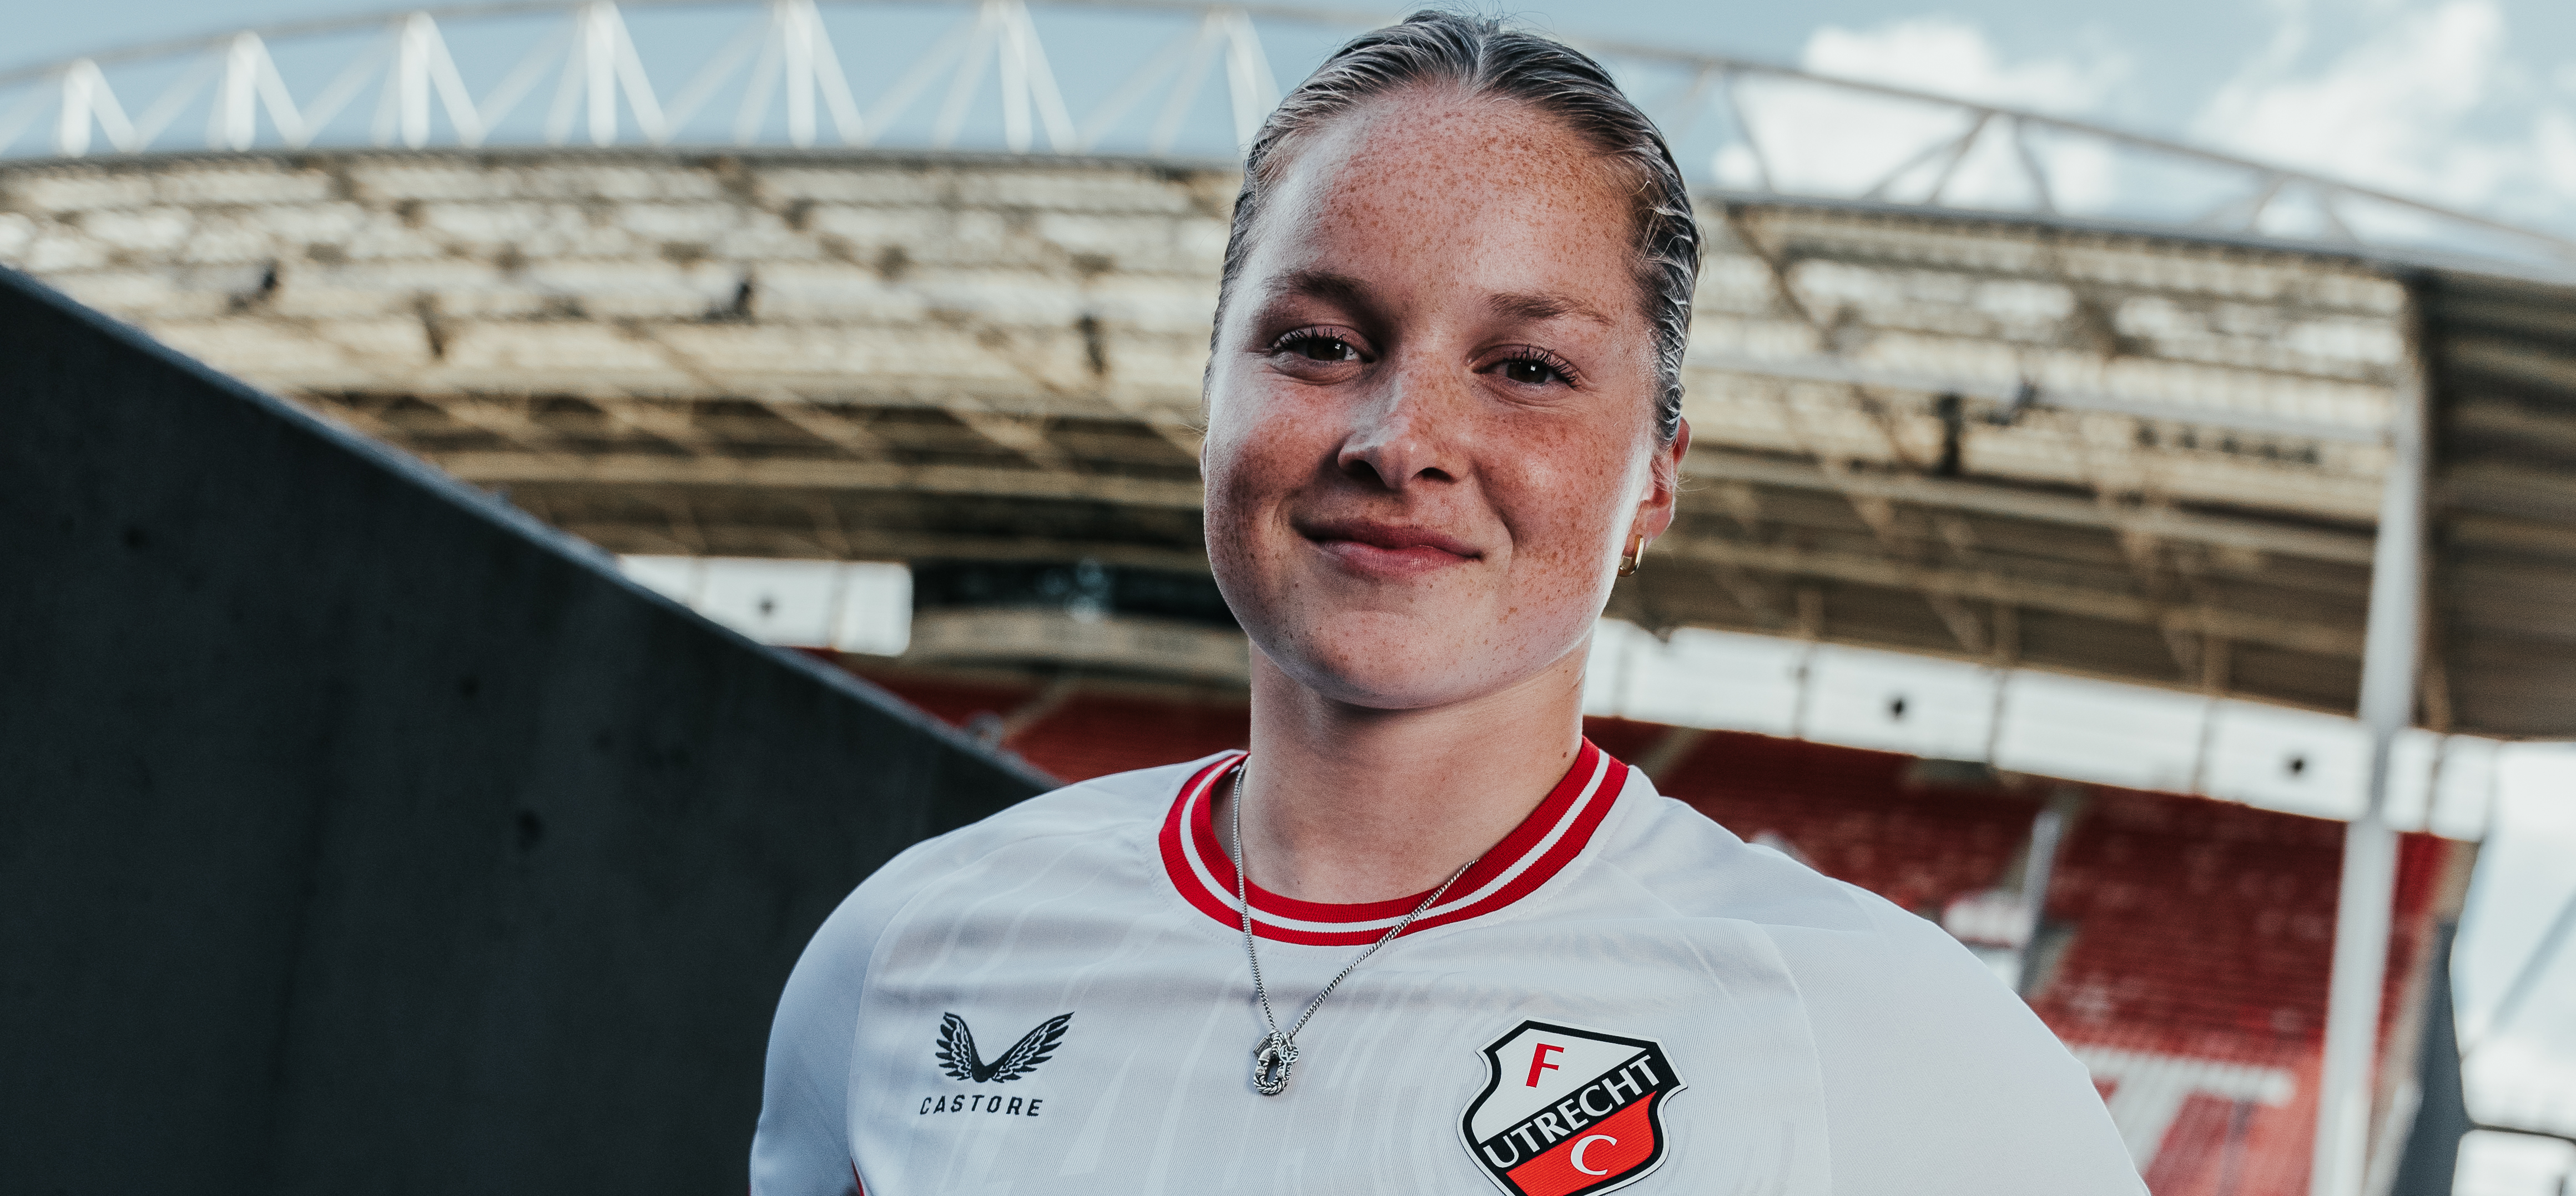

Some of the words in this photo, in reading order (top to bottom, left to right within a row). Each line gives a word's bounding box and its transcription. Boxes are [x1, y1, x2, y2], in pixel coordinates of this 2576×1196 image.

[1526, 1043, 1565, 1088] F
[920, 1094, 1043, 1117] CASTORE
[1483, 1054, 1660, 1168] UTRECHT
[1570, 1134, 1618, 1175] C
